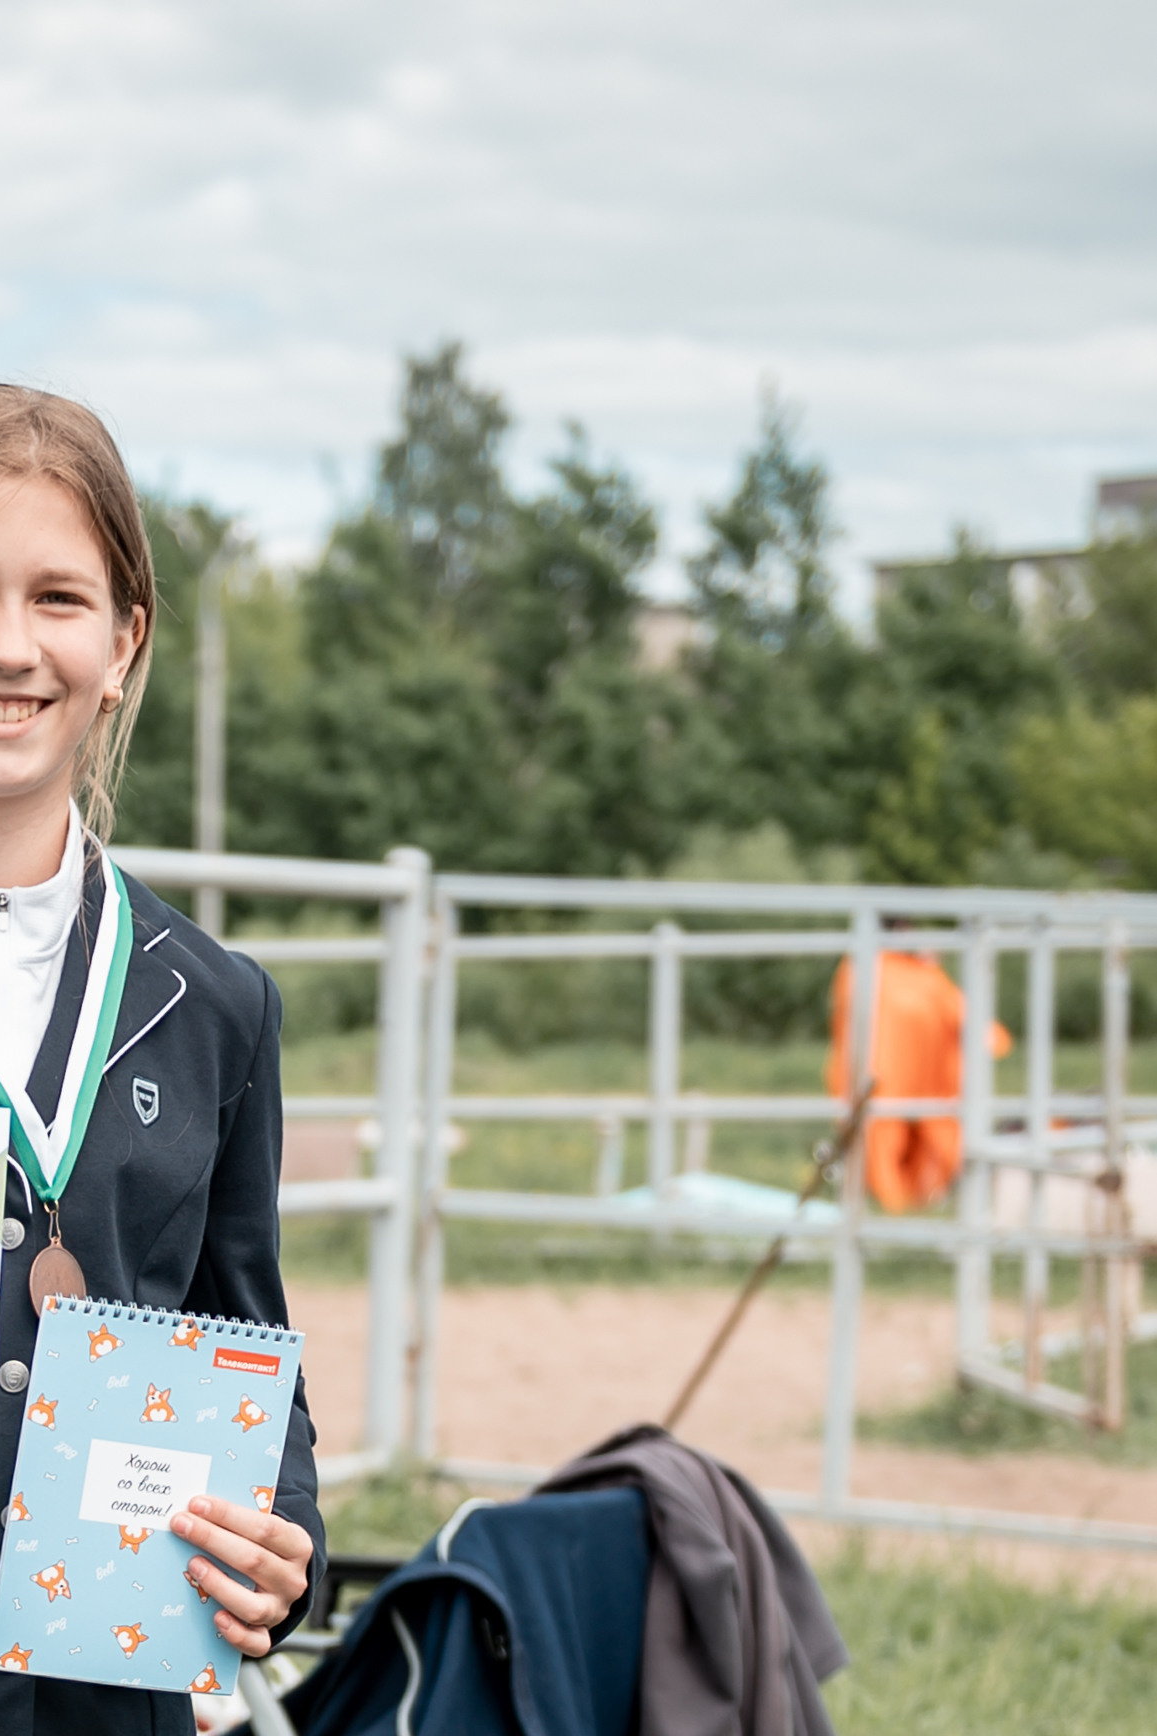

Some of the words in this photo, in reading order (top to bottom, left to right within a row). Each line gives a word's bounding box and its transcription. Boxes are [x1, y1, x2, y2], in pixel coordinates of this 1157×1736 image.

[217, 1356, 276, 1374] Телеконтакт!
[125, 1453, 172, 1473] Хорош
[117, 1479, 133, 1489] со
[138, 1475, 172, 1495] всех
[110, 1500, 173, 1518] сторон!
[161, 1604, 185, 1616] Bell
